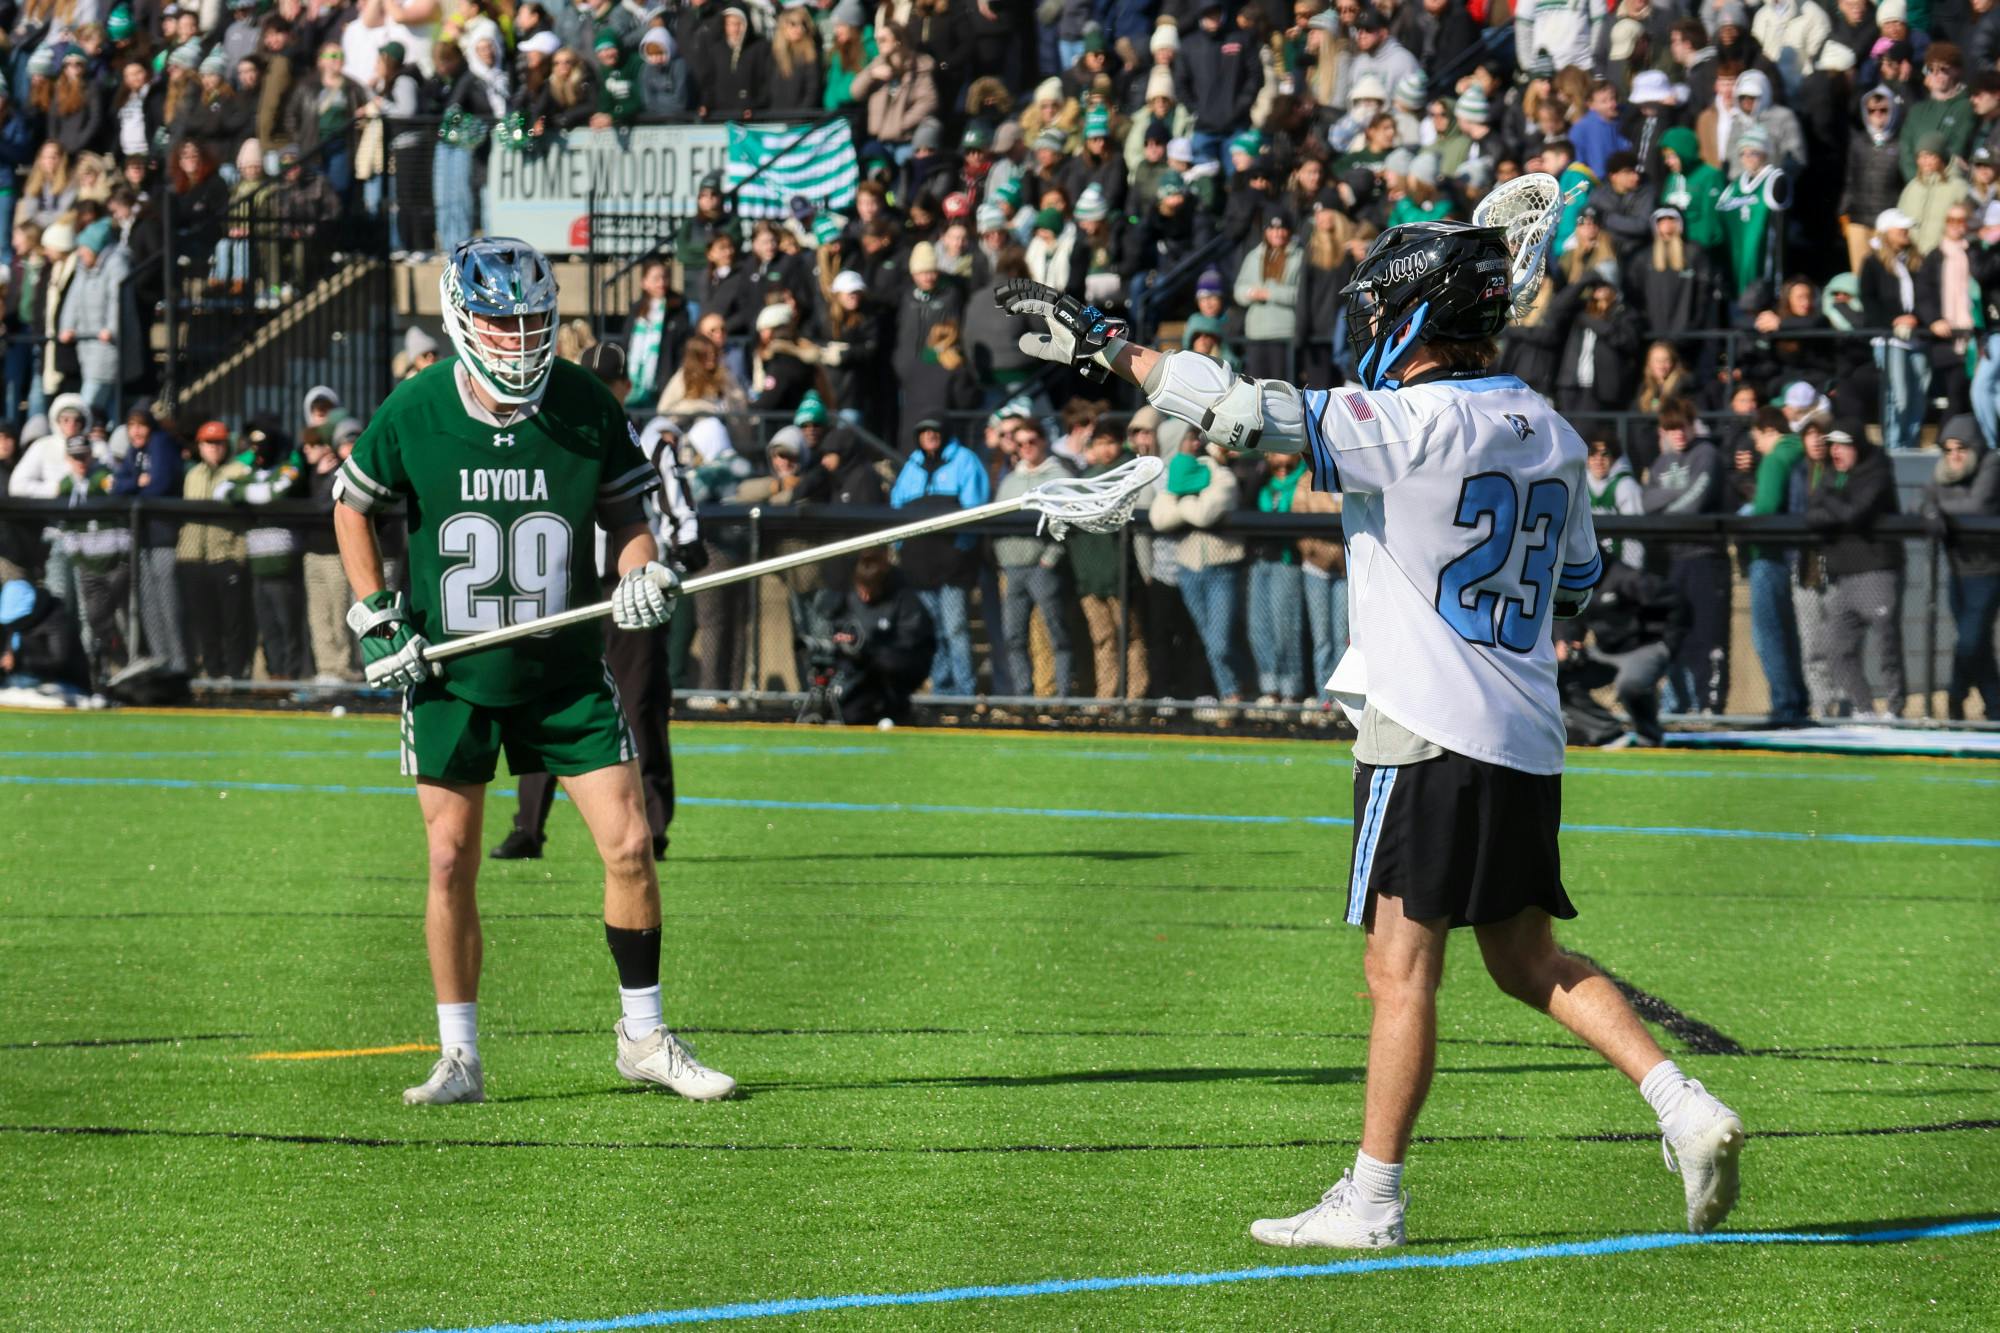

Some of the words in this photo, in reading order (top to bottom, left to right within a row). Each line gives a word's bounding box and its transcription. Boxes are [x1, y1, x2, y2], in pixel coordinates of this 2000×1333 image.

[500, 147, 677, 199] HOMEWOOD
[1382, 250, 1428, 287] Jays
[1491, 276, 1505, 287] 23
[1058, 309, 1075, 324] STX
[1227, 421, 1244, 448] STX
[459, 468, 549, 502] LOYOLA
[438, 511, 573, 638] 29
[1434, 470, 1570, 654] 23
